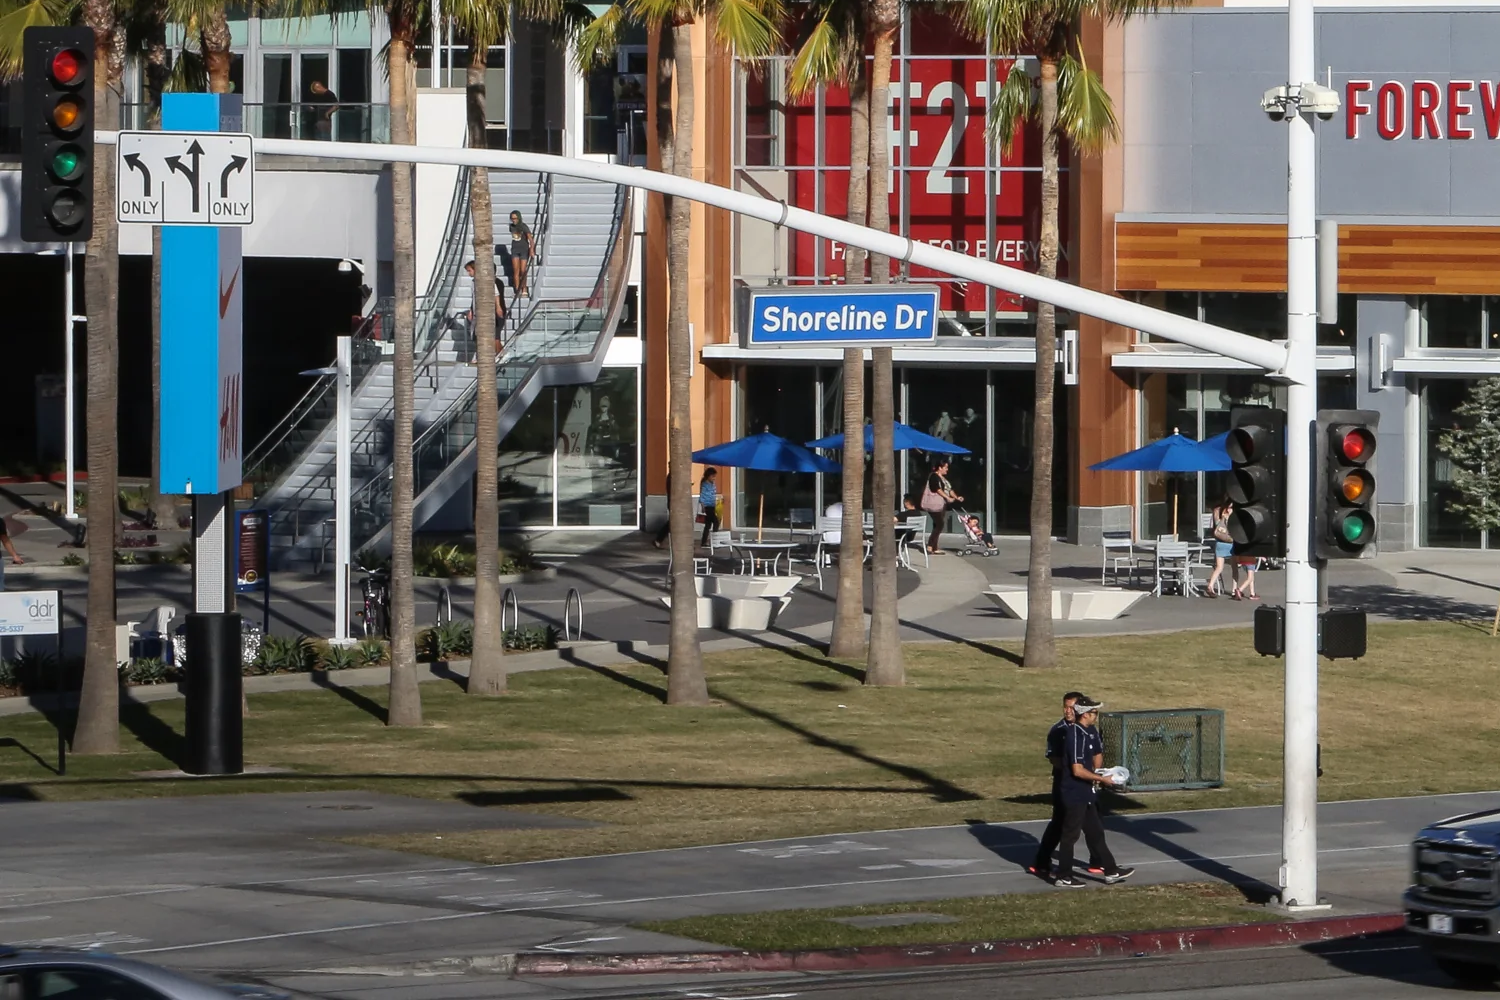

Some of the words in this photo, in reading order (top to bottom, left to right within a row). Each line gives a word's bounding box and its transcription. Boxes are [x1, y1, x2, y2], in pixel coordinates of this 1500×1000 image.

[887, 81, 1001, 195] F21
[121, 200, 160, 216] ONLY
[213, 201, 249, 216] ONLY
[762, 304, 886, 332] Shoreline
[894, 304, 927, 331] Dr
[28, 599, 54, 617] ddr
